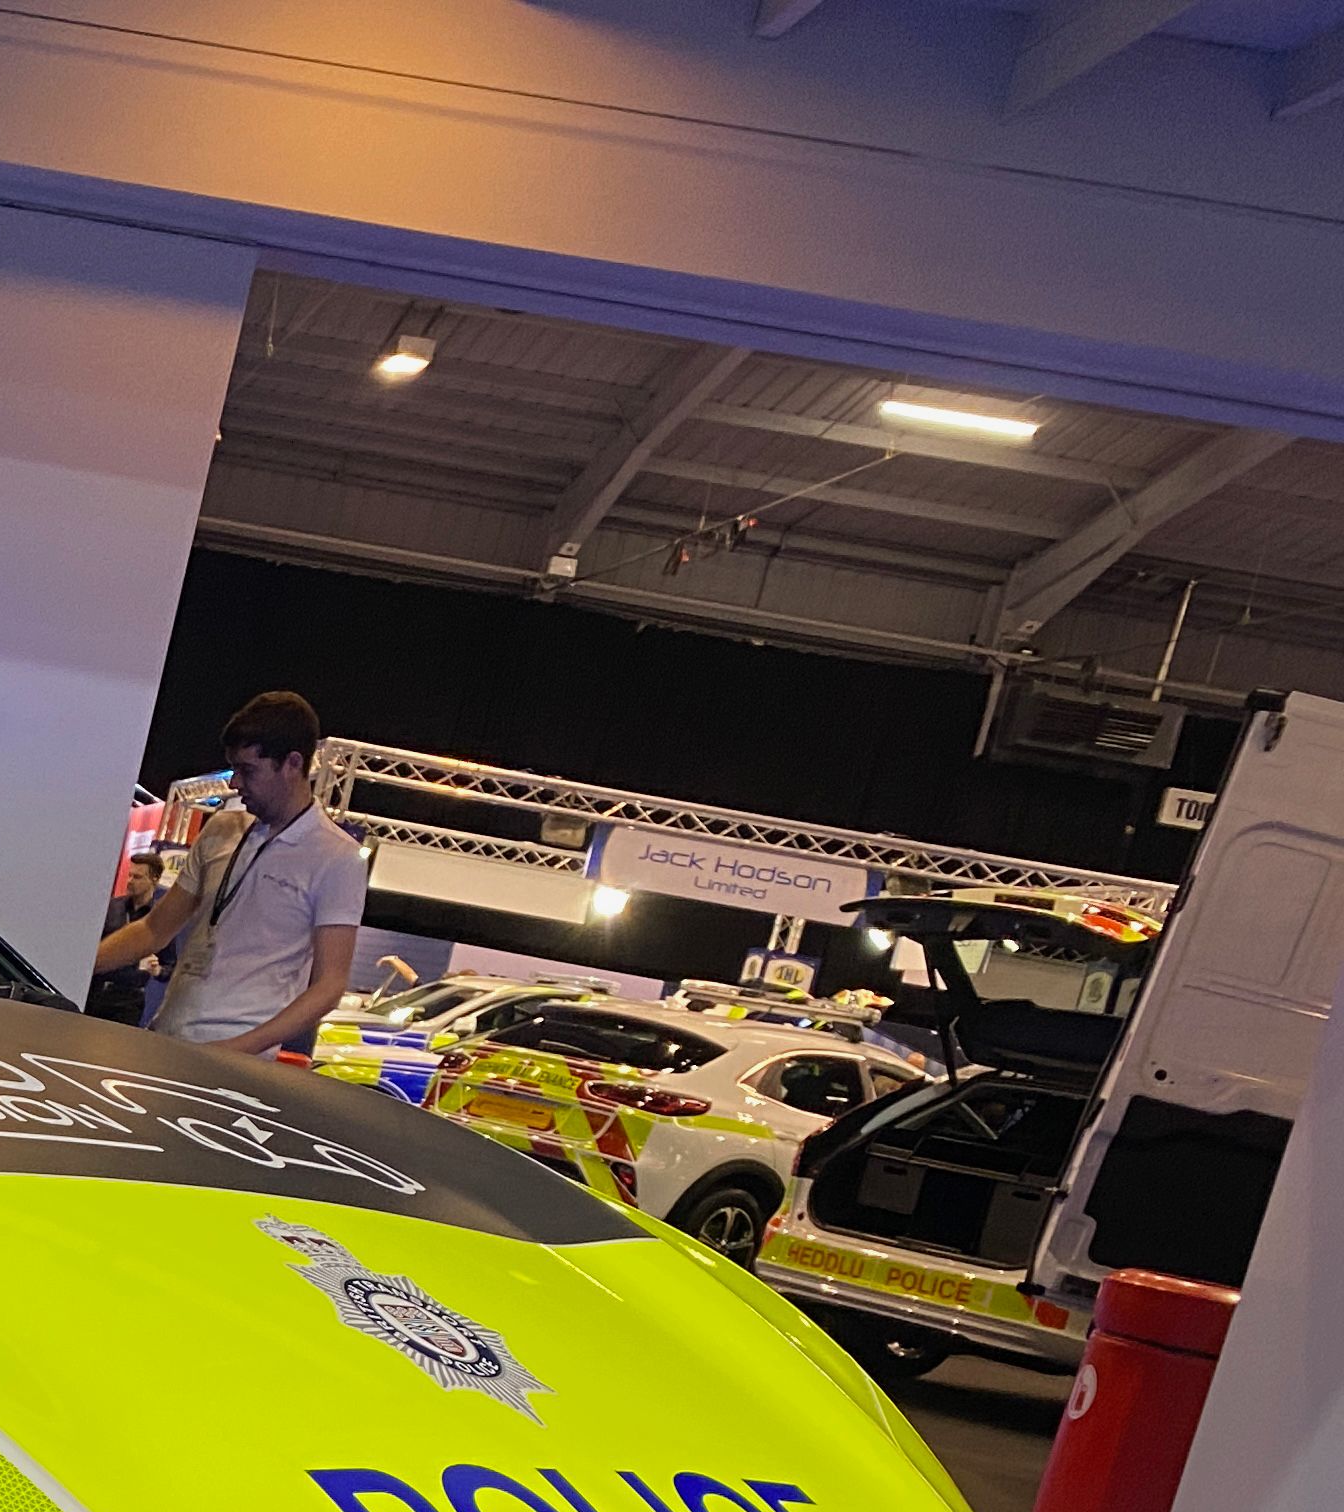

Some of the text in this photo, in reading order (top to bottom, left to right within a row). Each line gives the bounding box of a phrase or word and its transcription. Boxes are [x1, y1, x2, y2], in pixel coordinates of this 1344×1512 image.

[638, 844, 832, 894] Jack Hodson
[694, 876, 768, 900] Limited
[787, 1242, 974, 1304] HEDDLU POLICE
[345, 1279, 488, 1349] BRITISH TRANSPORT
[438, 1356, 500, 1377] POLICE
